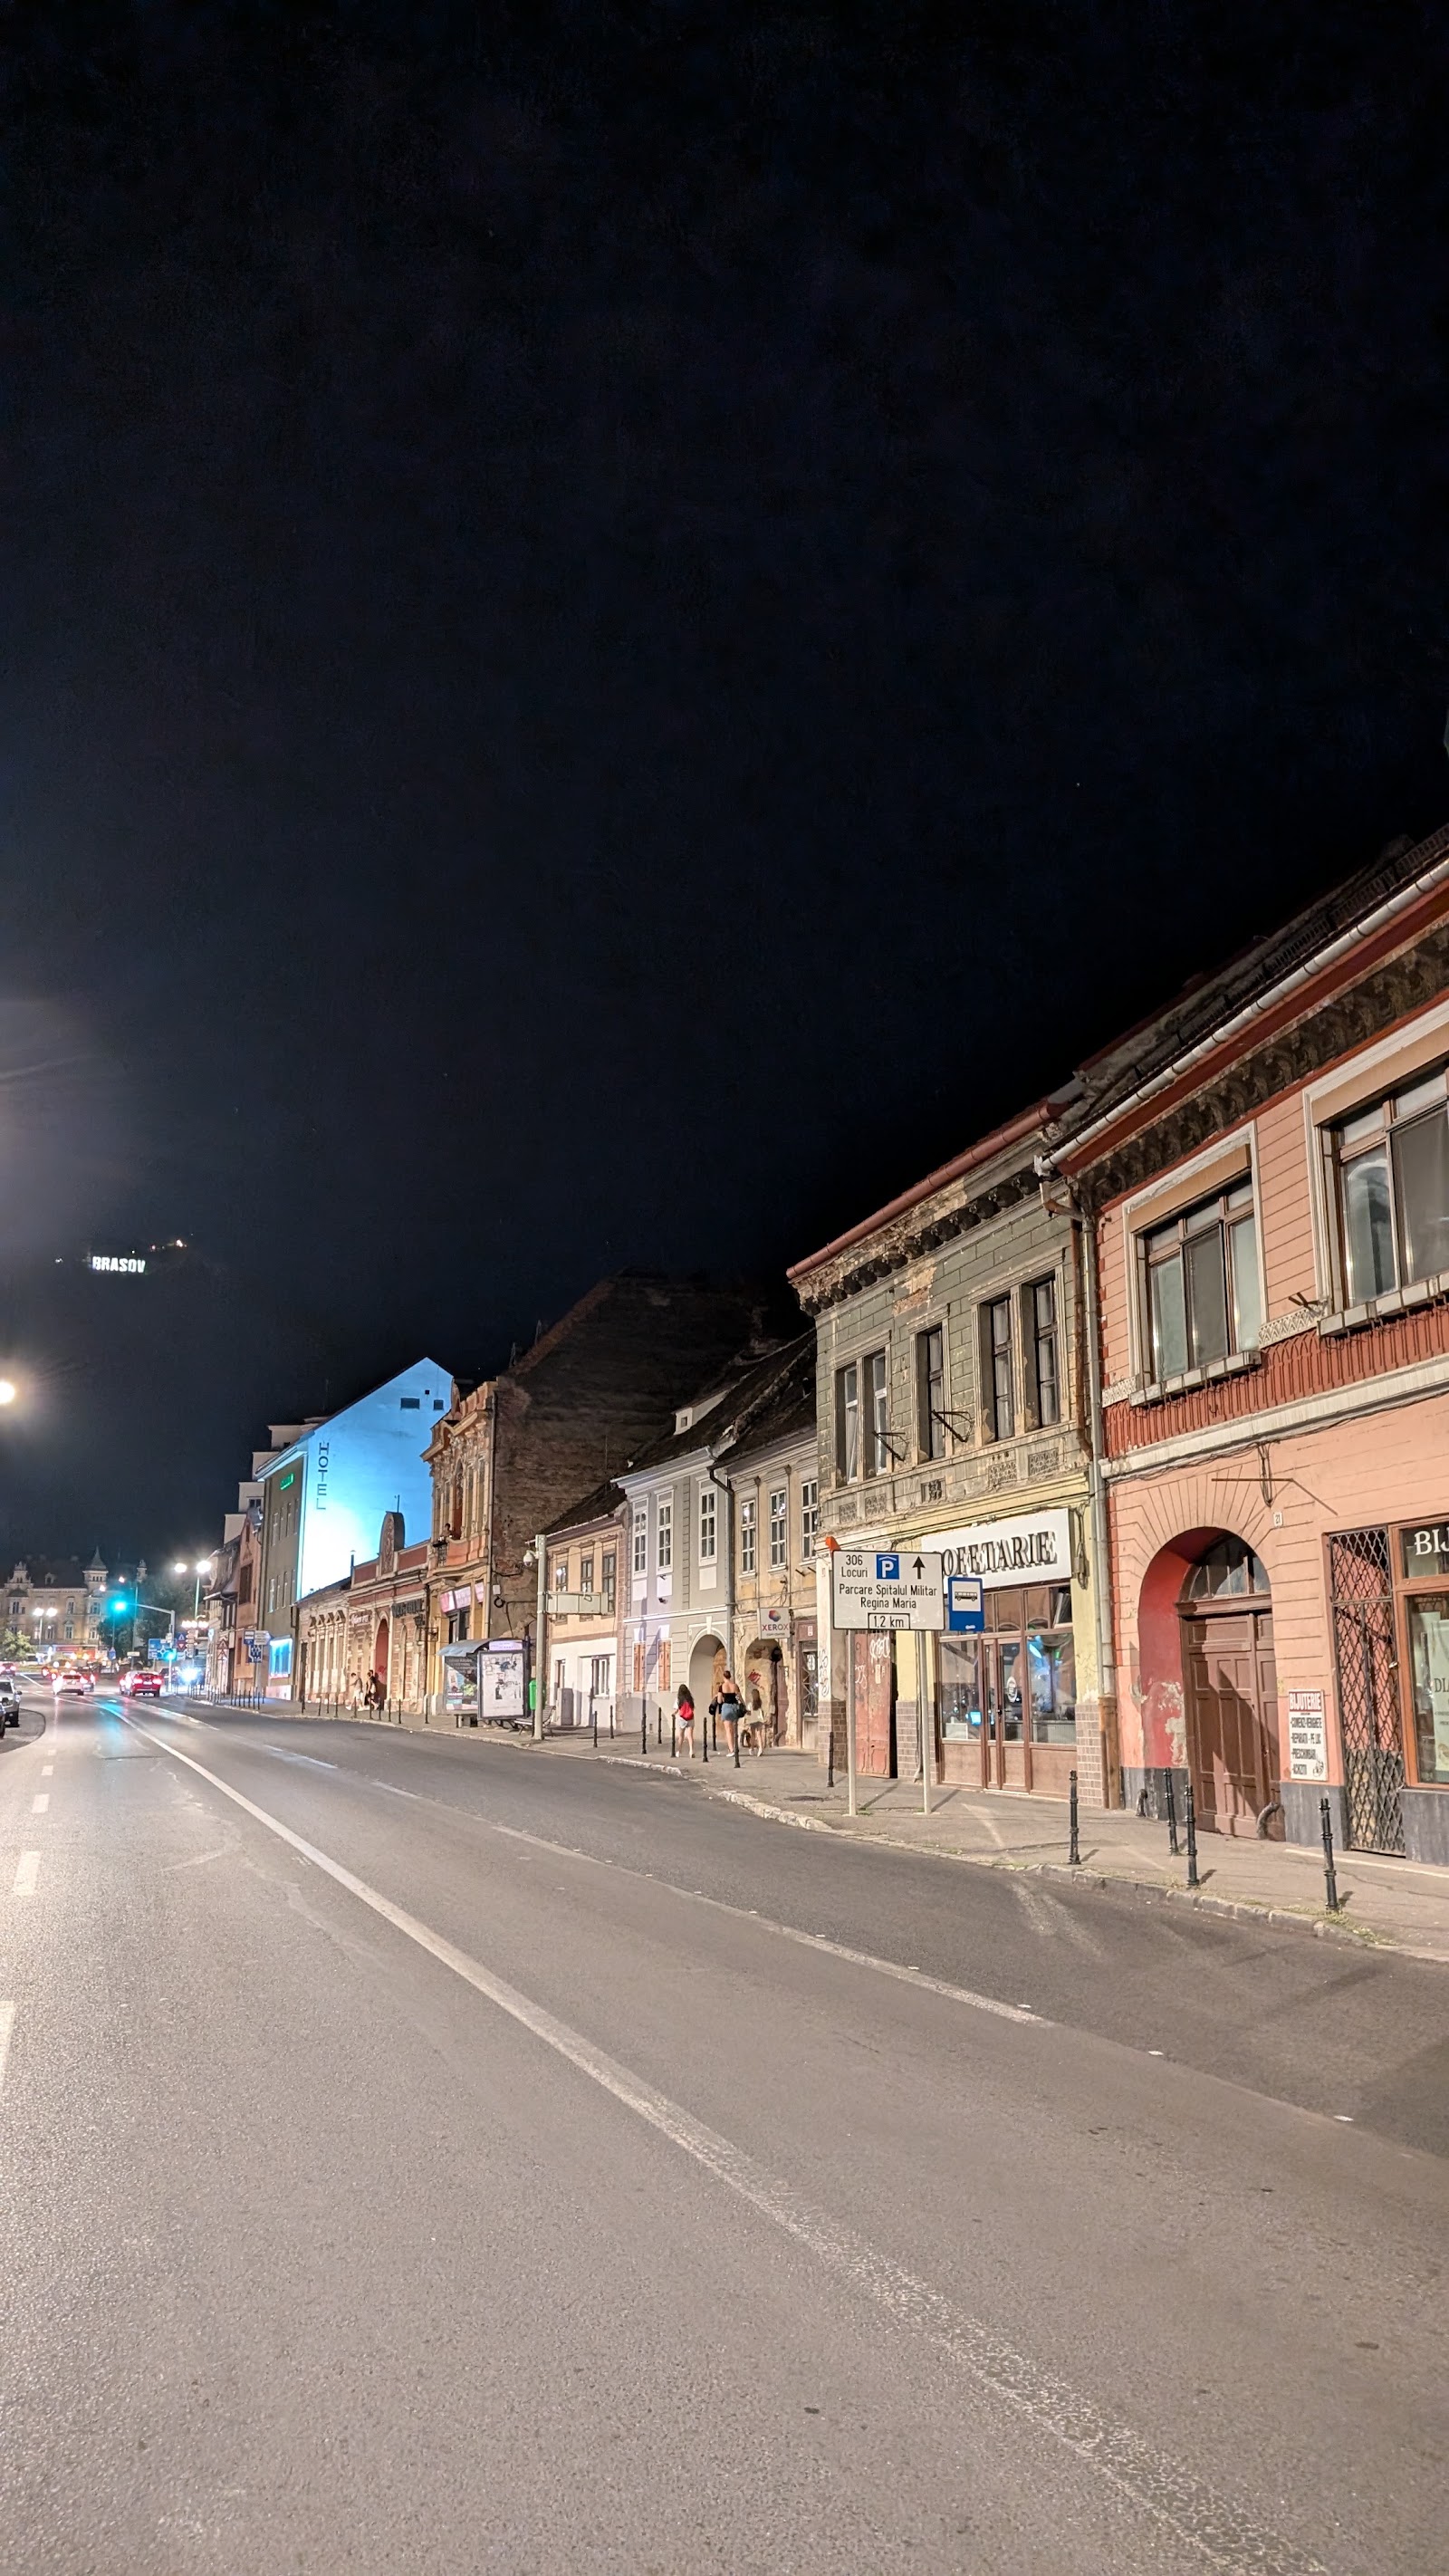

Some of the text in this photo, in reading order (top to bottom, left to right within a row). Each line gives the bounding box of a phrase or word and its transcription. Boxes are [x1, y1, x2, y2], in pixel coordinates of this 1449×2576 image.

[92, 1255, 146, 1273] BRASOV
[316, 1442, 330, 1510] HOTEL
[846, 1554, 863, 1566] 306
[942, 1531, 1058, 1577] OFETARIE
[841, 1566, 868, 1578] Locuri
[839, 1583, 937, 1598] Parcare Spitalul Militar
[860, 1597, 916, 1610] Regina Maria
[762, 1623, 788, 1631] XEROX
[889, 1616, 904, 1628] km
[1289, 1692, 1321, 1711] BIJUTERIE
